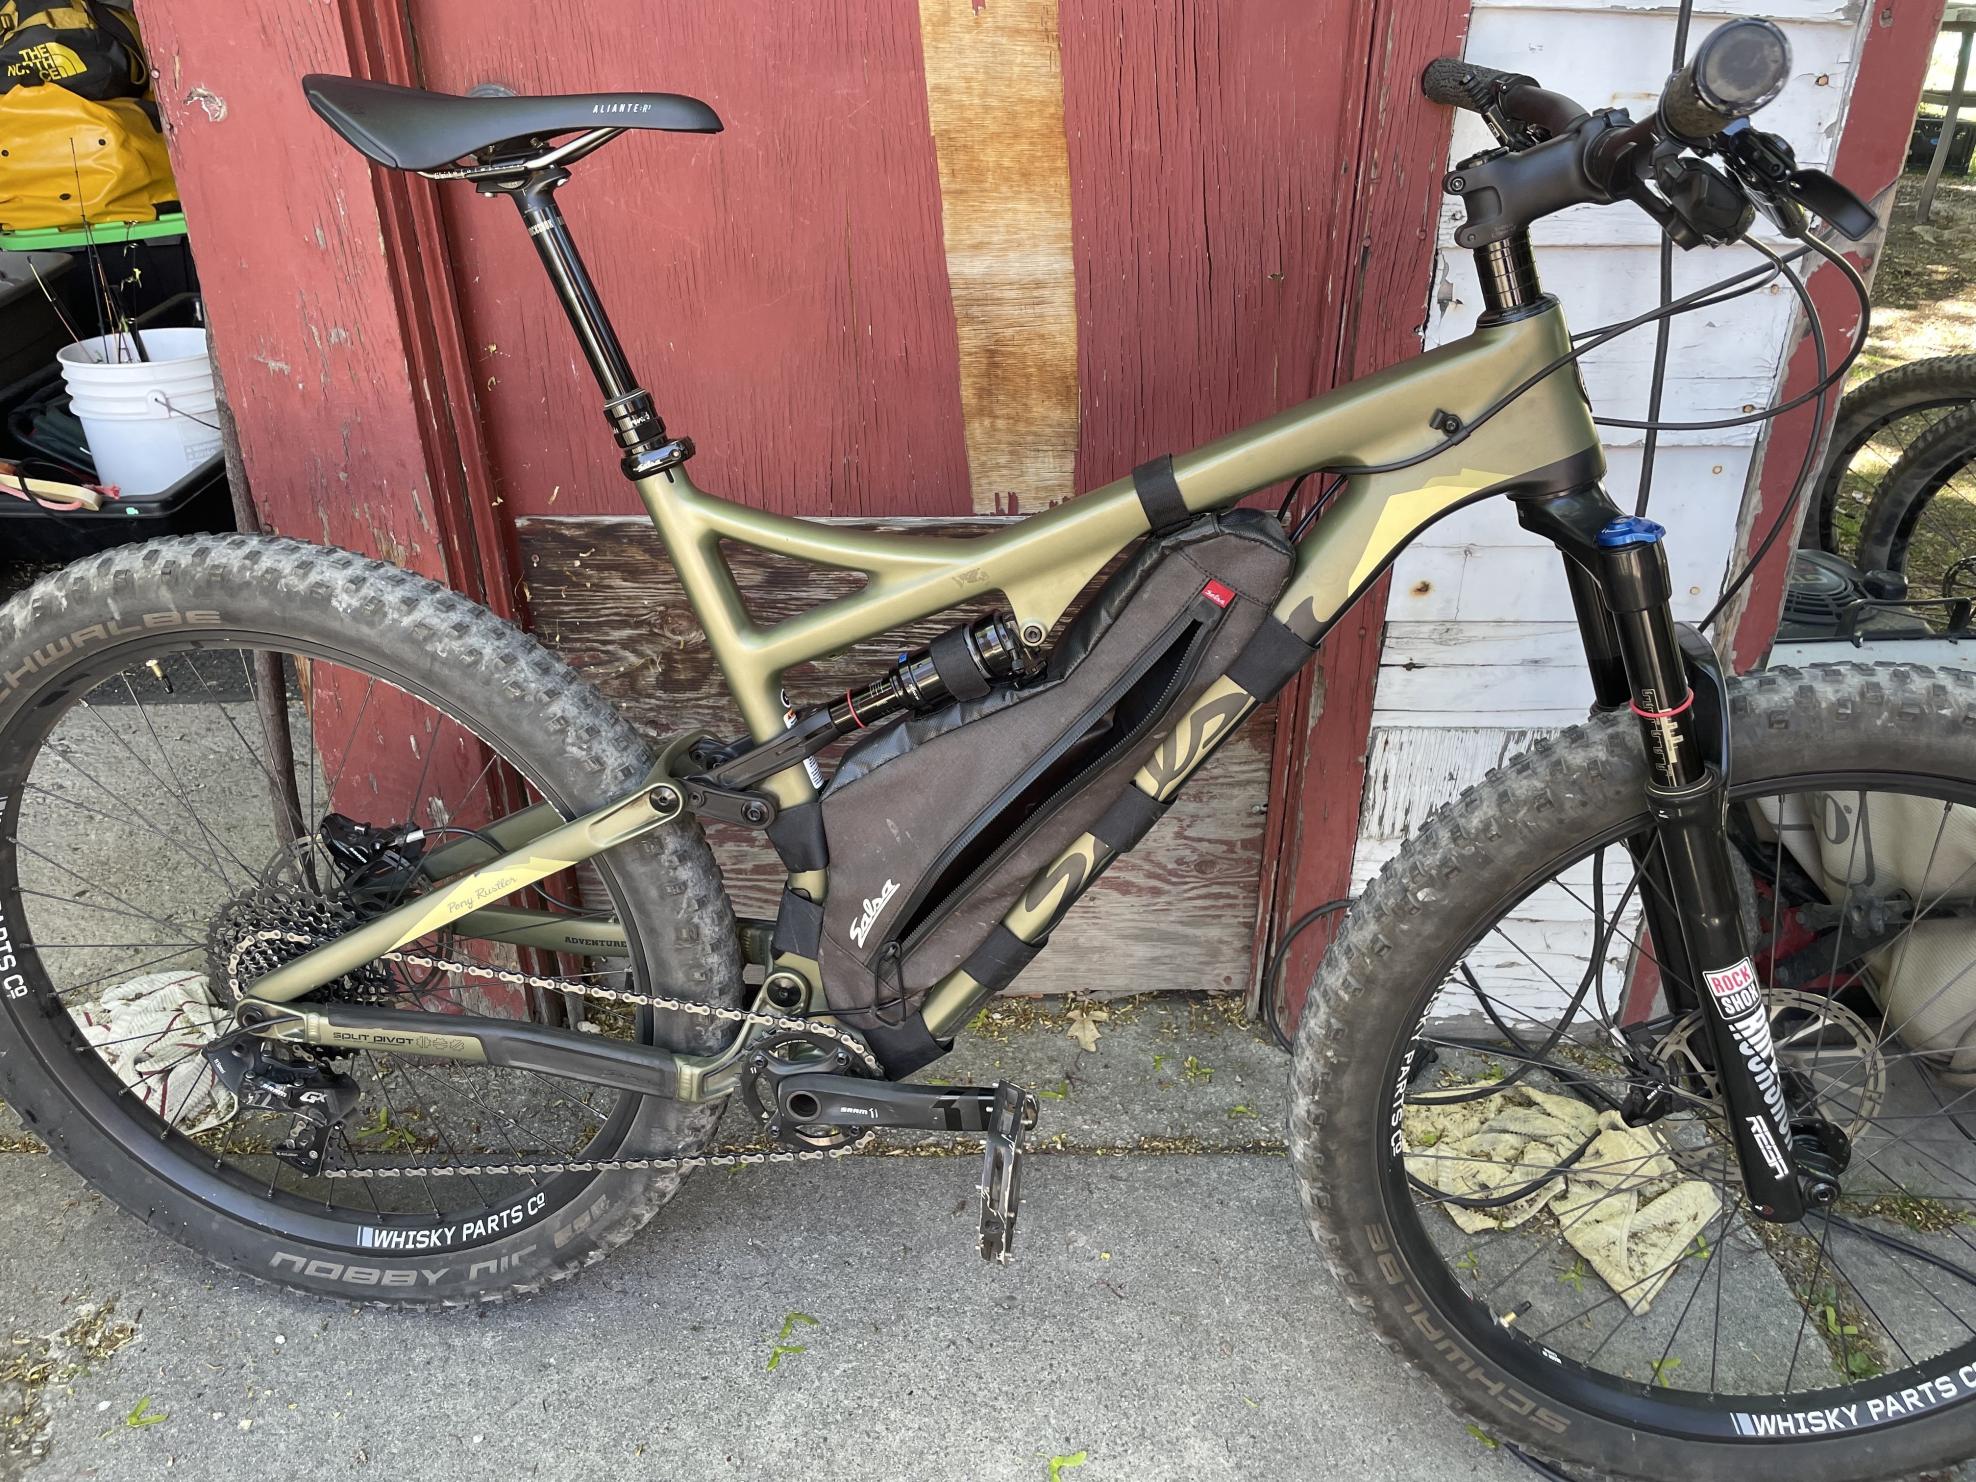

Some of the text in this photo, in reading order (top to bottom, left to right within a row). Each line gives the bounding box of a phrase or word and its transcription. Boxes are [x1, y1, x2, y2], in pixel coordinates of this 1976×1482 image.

[19, 44, 50, 62] THE
[0, 609, 222, 702] HWALBE
[447, 874, 519, 913] Pony Rustler
[849, 878, 901, 949] Salsa
[564, 936, 628, 948] ADVENTURE
[1710, 963, 1751, 994] ROCK
[1720, 983, 1760, 1015] SHOX
[373, 1035, 415, 1046] PIVOT
[299, 1091, 328, 1104] GX
[1391, 1050, 1416, 1127] PARTS
[373, 1226, 456, 1249] WHISKY
[462, 1205, 523, 1242] PARTS
[1752, 1404, 1858, 1436] WHISKY
[1866, 1375, 1958, 1421] PARTS
